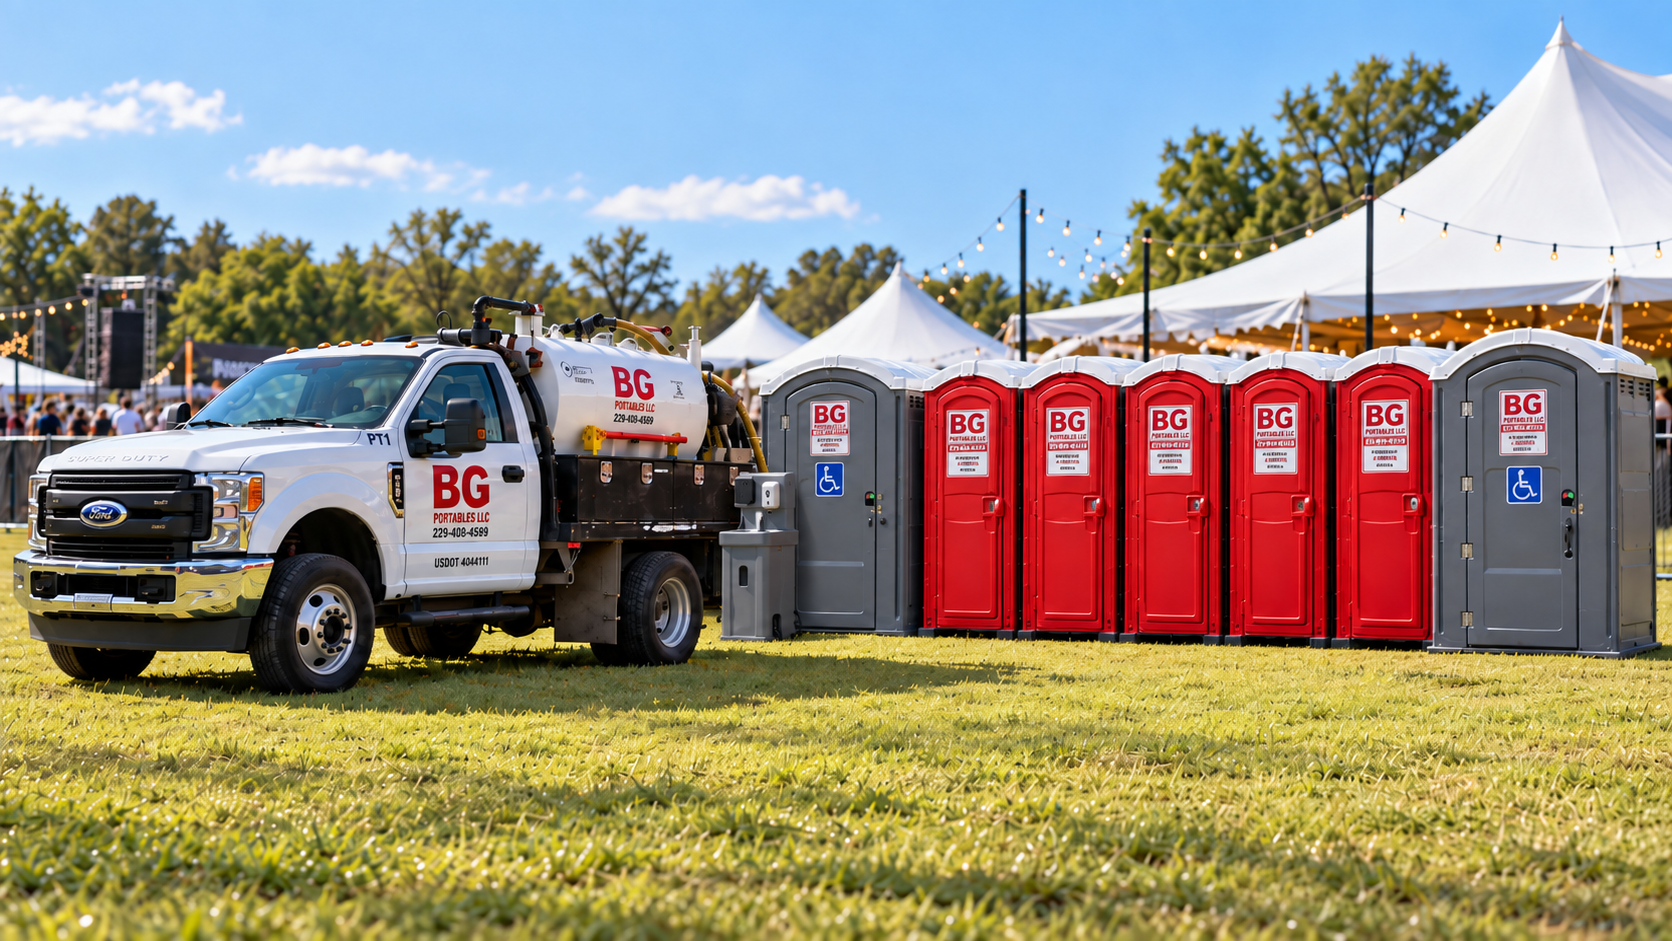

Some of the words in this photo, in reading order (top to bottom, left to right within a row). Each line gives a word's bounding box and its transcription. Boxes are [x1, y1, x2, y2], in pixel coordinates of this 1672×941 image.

[611, 366, 655, 400] BG
[814, 404, 846, 424] BG
[1504, 393, 1541, 415] BG
[950, 413, 985, 434] BG
[1050, 411, 1086, 432] BG
[1152, 409, 1188, 431] BG
[1257, 407, 1293, 429] BG
[1366, 404, 1404, 426] BG
[367, 433, 391, 445] PT1
[67, 455, 116, 463] SUPER
[121, 454, 169, 463] DUTY
[432, 465, 490, 509] BG
[88, 505, 113, 520] Ford
[433, 512, 476, 524] PORTABLES
[476, 511, 490, 523] LLC
[434, 557, 460, 568] USDOT
[460, 556, 489, 567] 4044111
